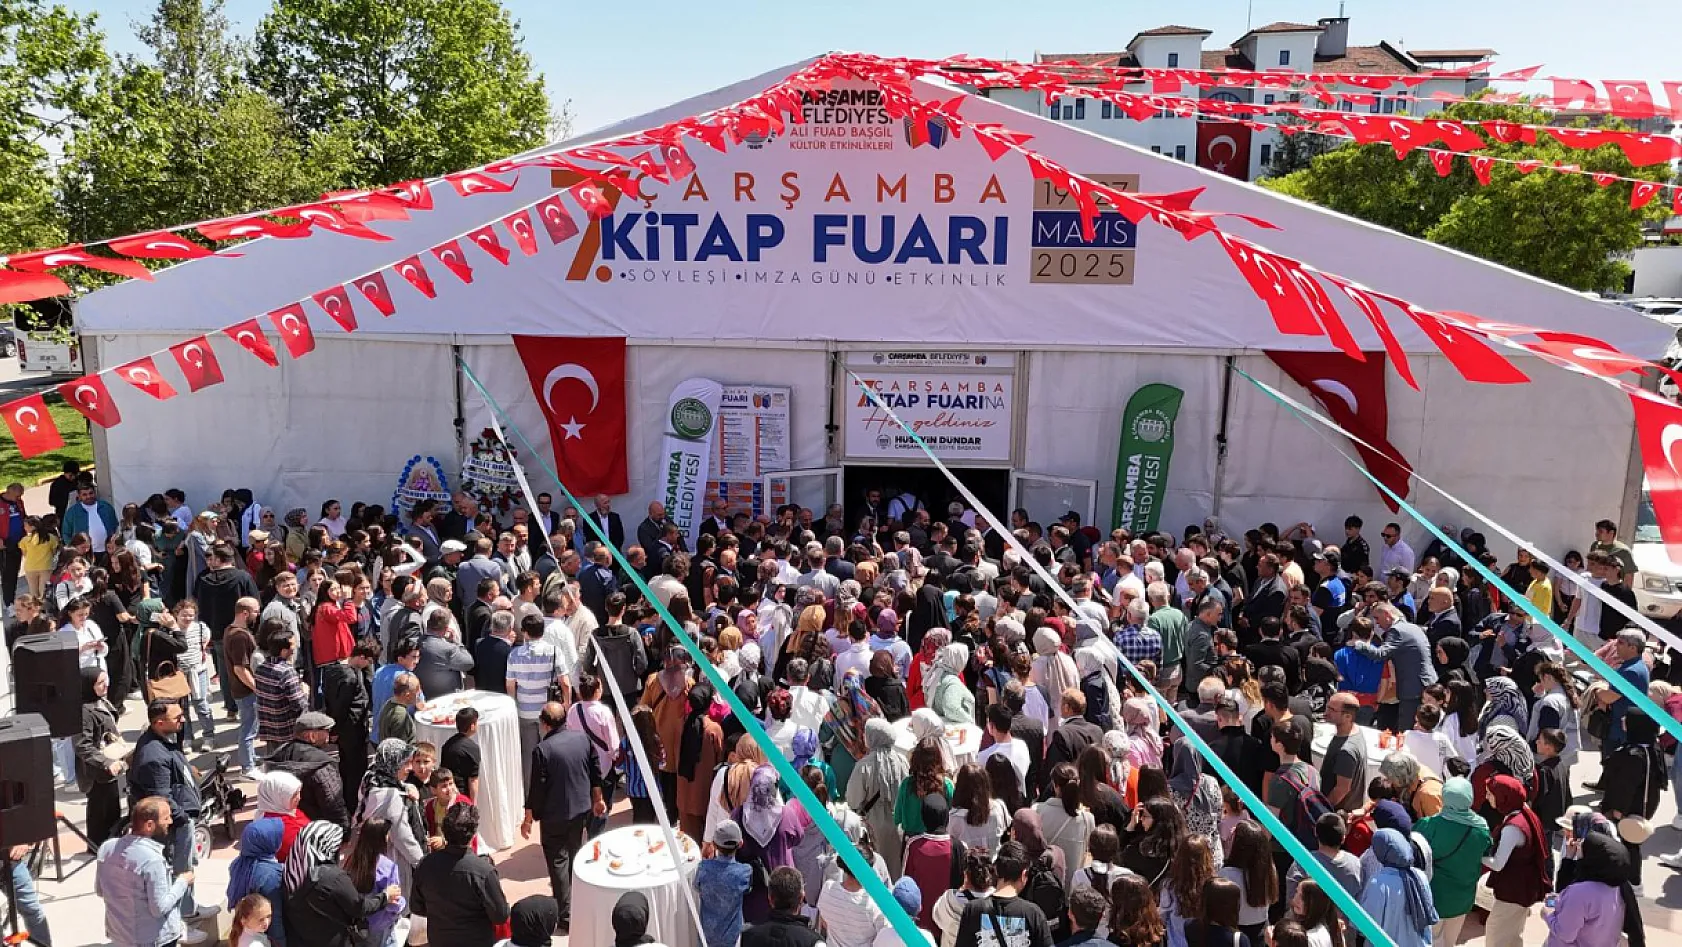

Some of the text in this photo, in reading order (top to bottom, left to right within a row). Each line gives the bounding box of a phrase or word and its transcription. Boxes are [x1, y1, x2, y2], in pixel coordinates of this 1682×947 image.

[790, 126, 893, 139] ALİ FUAD BAŞGİL
[790, 140, 893, 150] KÜLTÜR ETKİNLİKLERİ
[637, 172, 1007, 211] ÇARŞAMBA
[813, 213, 1009, 265] FUARI
[1036, 253, 1125, 278] 2025
[811, 270, 876, 285] GÜNÜ
[874, 380, 1004, 393] ÇARŞAMBA
[721, 394, 748, 402] FUARI
[866, 393, 920, 408] KTAP
[914, 412, 997, 432] geldiniz
[894, 435, 938, 444] HÜSYİN
[665, 450, 682, 519] RŞAMBA
[1121, 453, 1142, 530] ARŞAMBA
[678, 453, 700, 538] BELEDİYESİ
